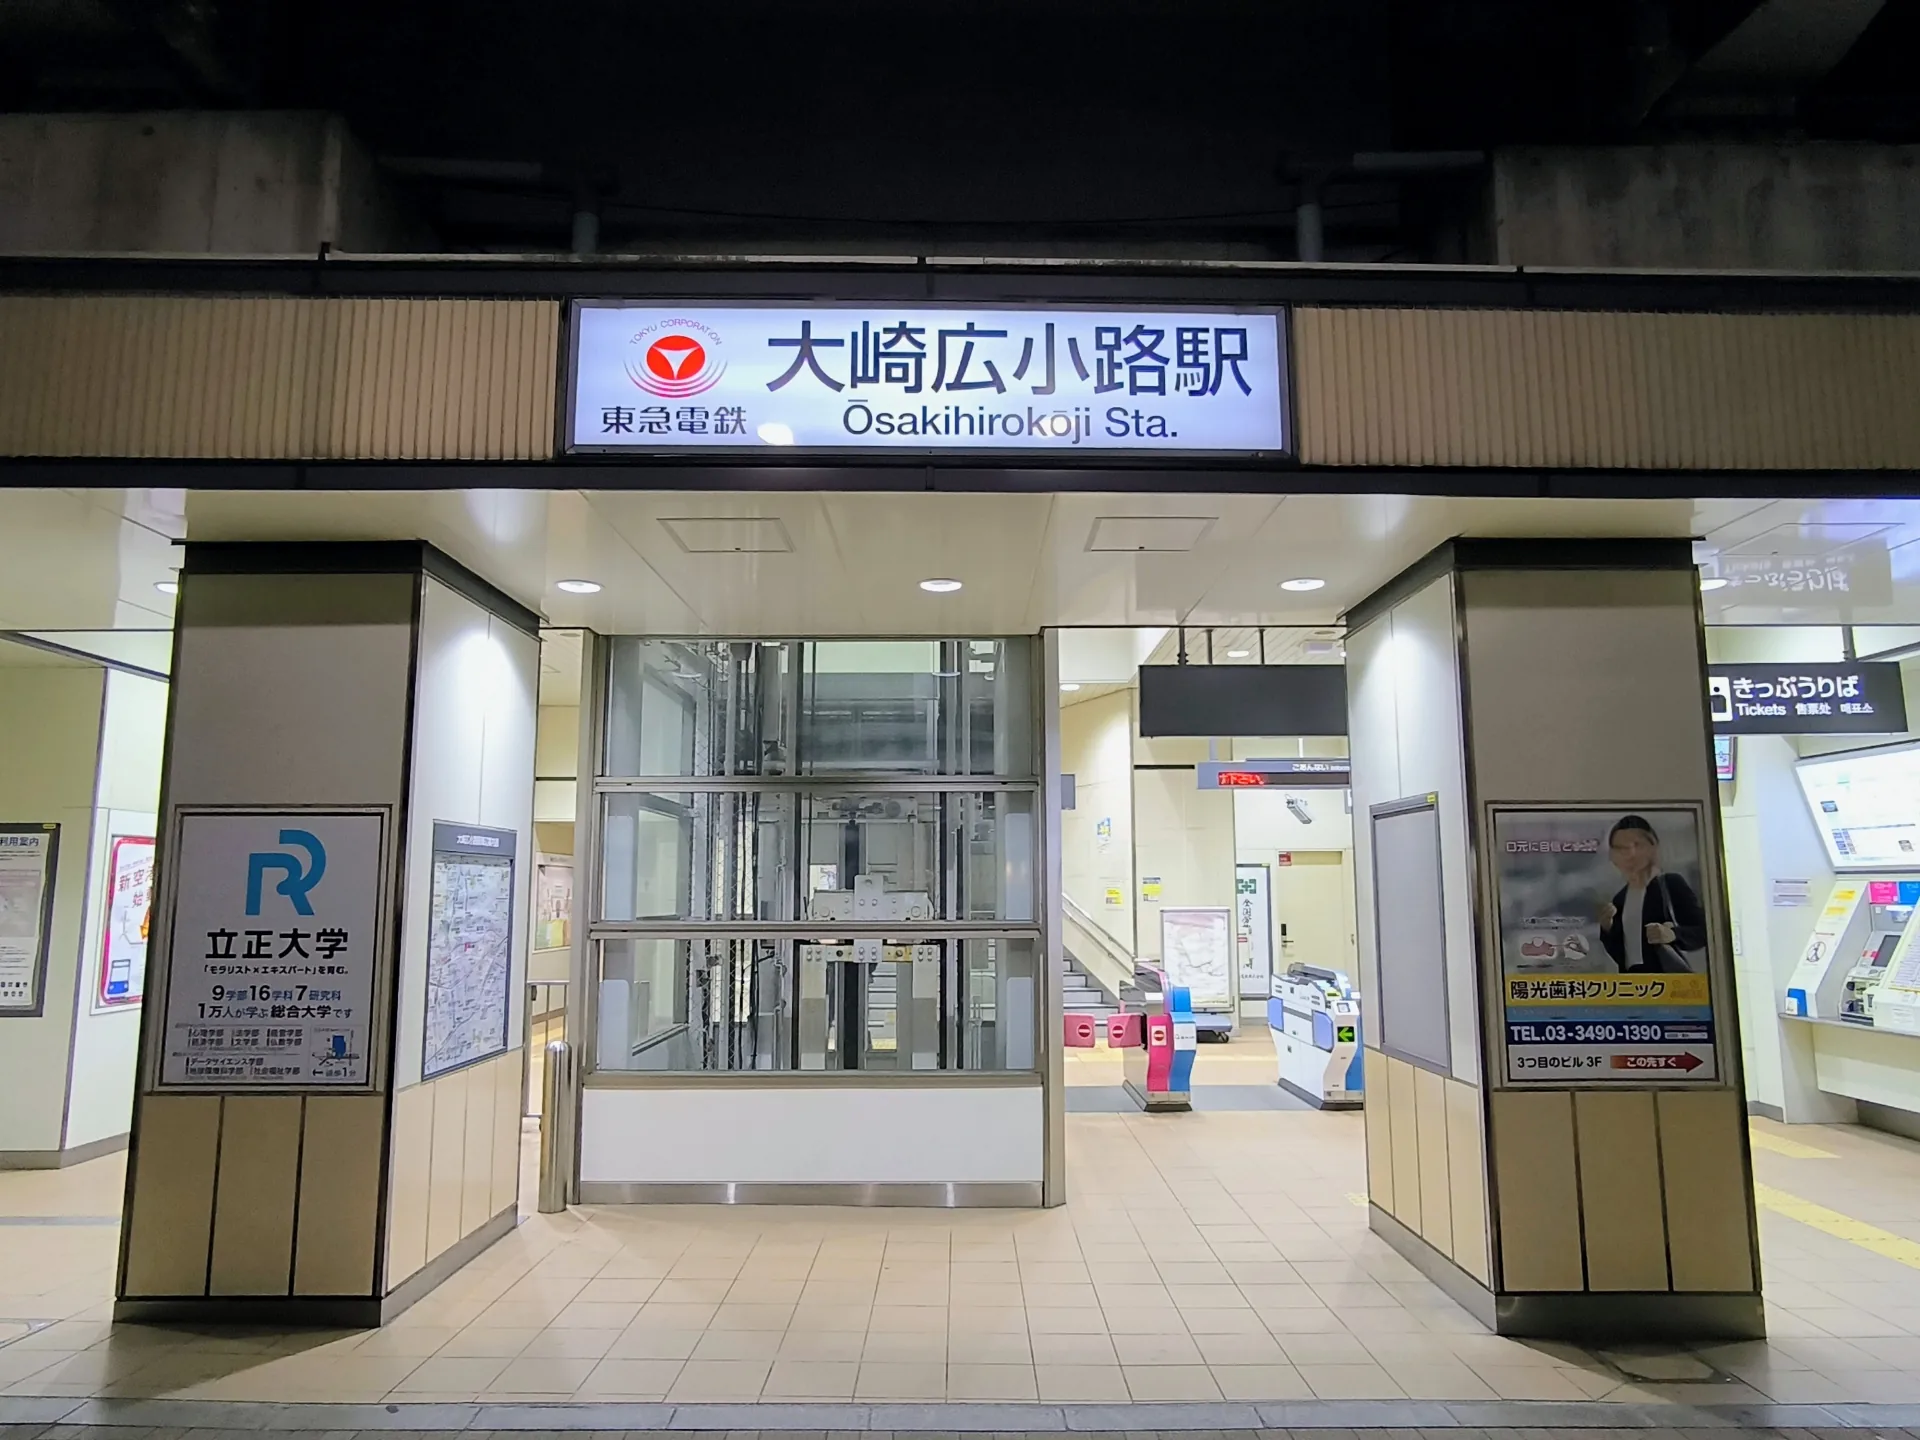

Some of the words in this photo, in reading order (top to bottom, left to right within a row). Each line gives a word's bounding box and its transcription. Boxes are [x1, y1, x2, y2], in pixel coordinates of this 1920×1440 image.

[630, 324, 658, 346] TOKYU
[661, 318, 722, 346] CORPORATION
[766, 320, 1252, 398] 大崎広小路駅
[601, 406, 747, 435] 東急電鉄
[843, 399, 1091, 440] Ōsakihirokōji
[1105, 406, 1178, 438] Sta.
[1733, 675, 1860, 699] きっぷうりば
[1736, 702, 1787, 716] Tickets
[205, 928, 348, 959] 立正大学
[1510, 980, 1666, 999] 陽光歯科クリニック
[1511, 1025, 1661, 1041] TEL.03-3490-1390
[1517, 1055, 1583, 1069] 3つ目のビル
[1587, 1055, 1602, 1068] 3F
[1626, 1055, 1677, 1068] この先すぐ
